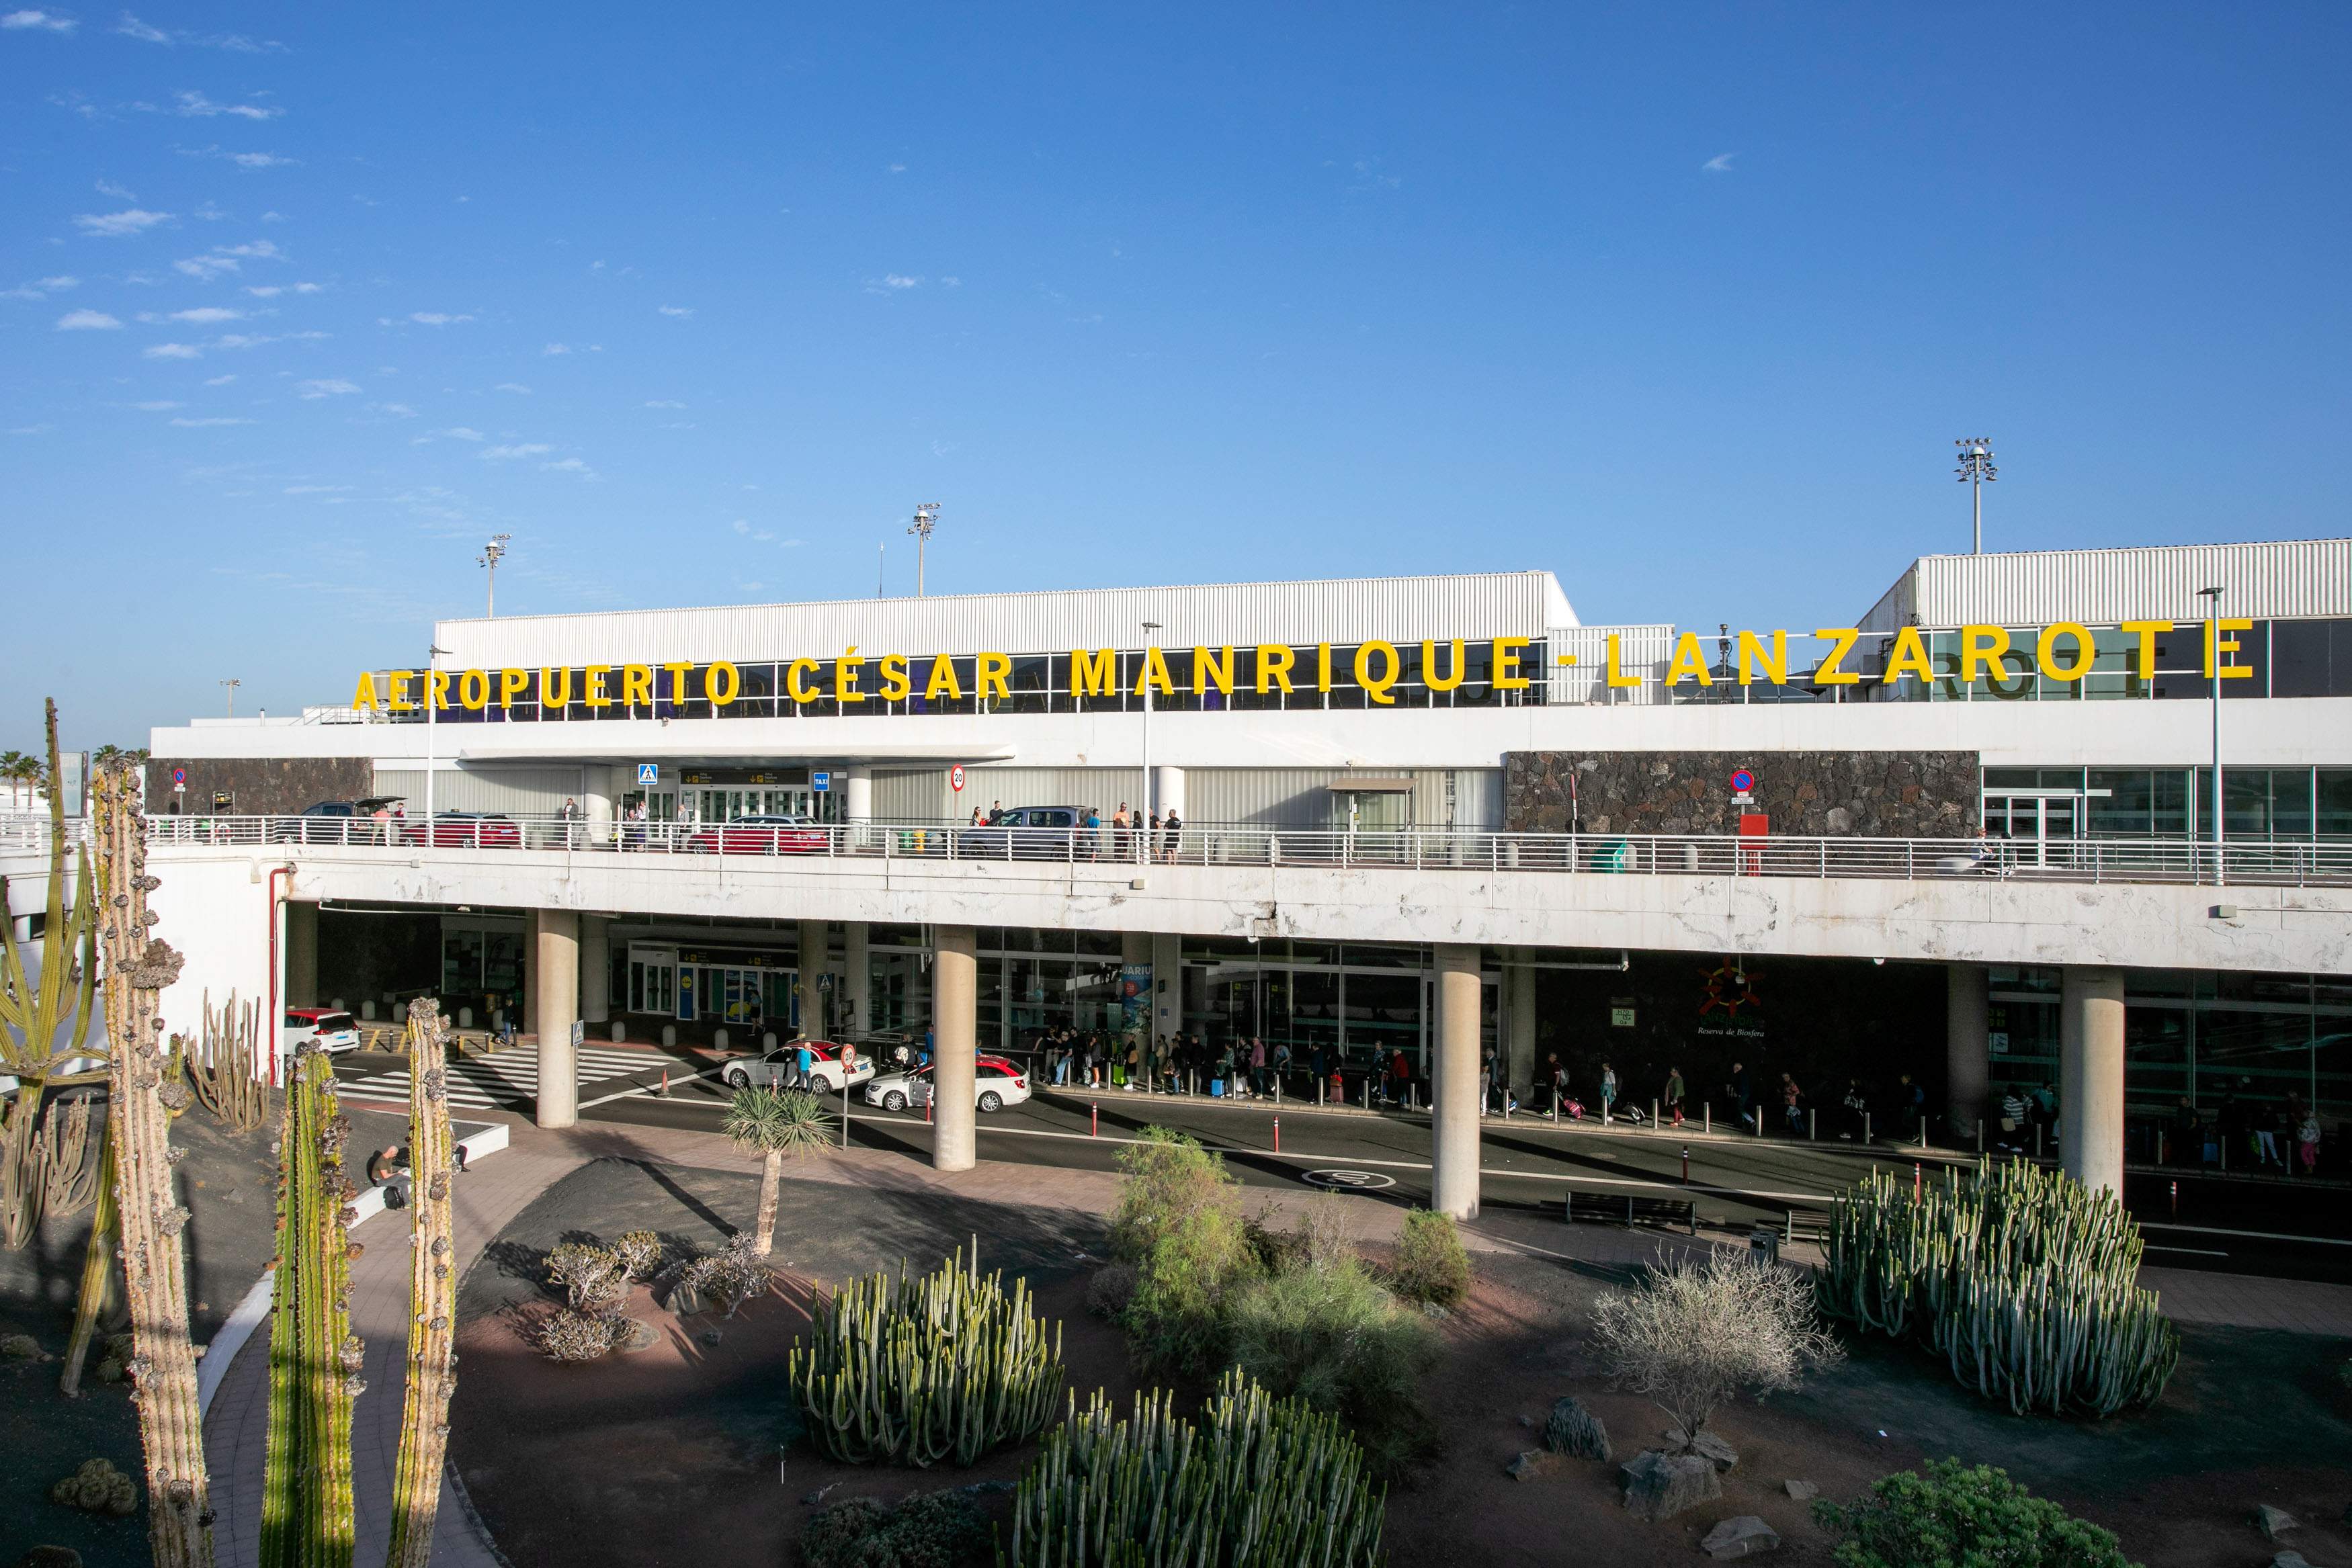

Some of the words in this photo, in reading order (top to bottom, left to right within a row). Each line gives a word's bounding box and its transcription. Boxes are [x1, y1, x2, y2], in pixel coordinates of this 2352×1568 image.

[351, 661, 739, 711] AEROPUERTO
[787, 646, 1012, 703] CÉSAR
[1070, 636, 1530, 704] MANRIQUE
[1608, 619, 2253, 687] LANZAROTE
[955, 773, 962, 782] 20
[1697, 1027, 1724, 1035] Reserva
[1726, 1028, 1734, 1036] de
[1736, 1029, 1765, 1038] Biosfera
[845, 1052, 852, 1060] 20
